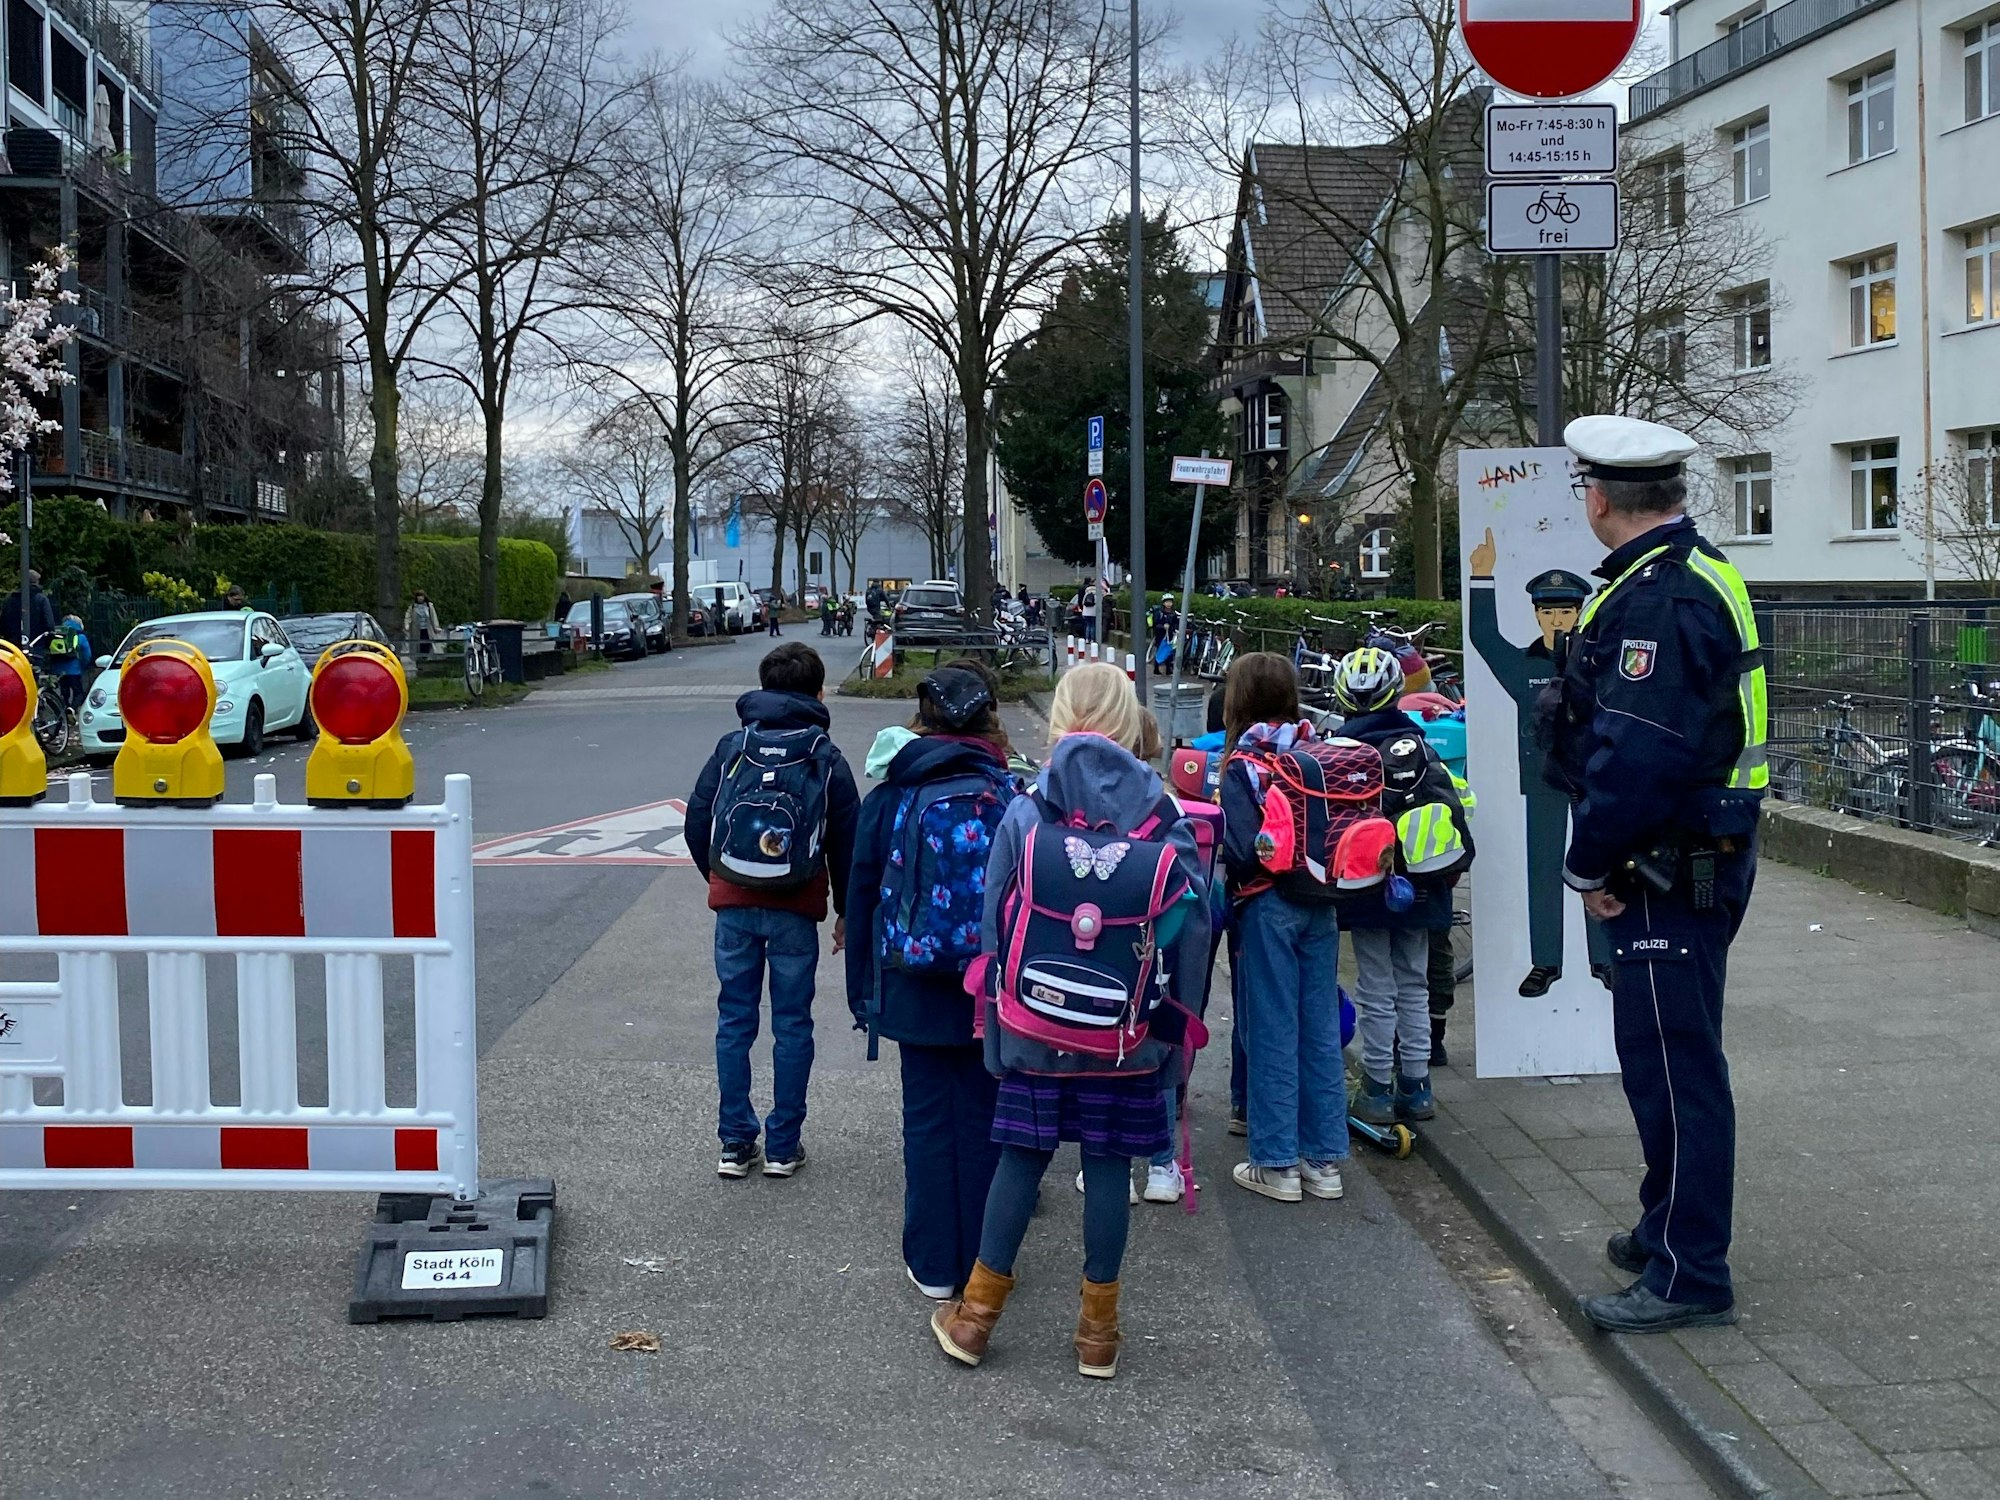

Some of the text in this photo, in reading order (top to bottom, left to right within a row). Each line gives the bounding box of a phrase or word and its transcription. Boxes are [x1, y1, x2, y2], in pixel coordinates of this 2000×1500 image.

[1496, 118, 1605, 131] Mo-Fr 7:45-8:30 h
[1541, 135, 1564, 146] und
[1508, 150, 1591, 163] 14:45-15:15 h
[1539, 228, 1568, 244] frei
[1091, 421, 1100, 447] P
[1176, 463, 1226, 476] Feuerwehrzufahrt
[1624, 641, 1655, 650] POLIZEI
[1633, 939, 1668, 951] POLIZEI
[413, 1257, 495, 1270] Stadt Köln
[433, 1271, 472, 1282] 644
